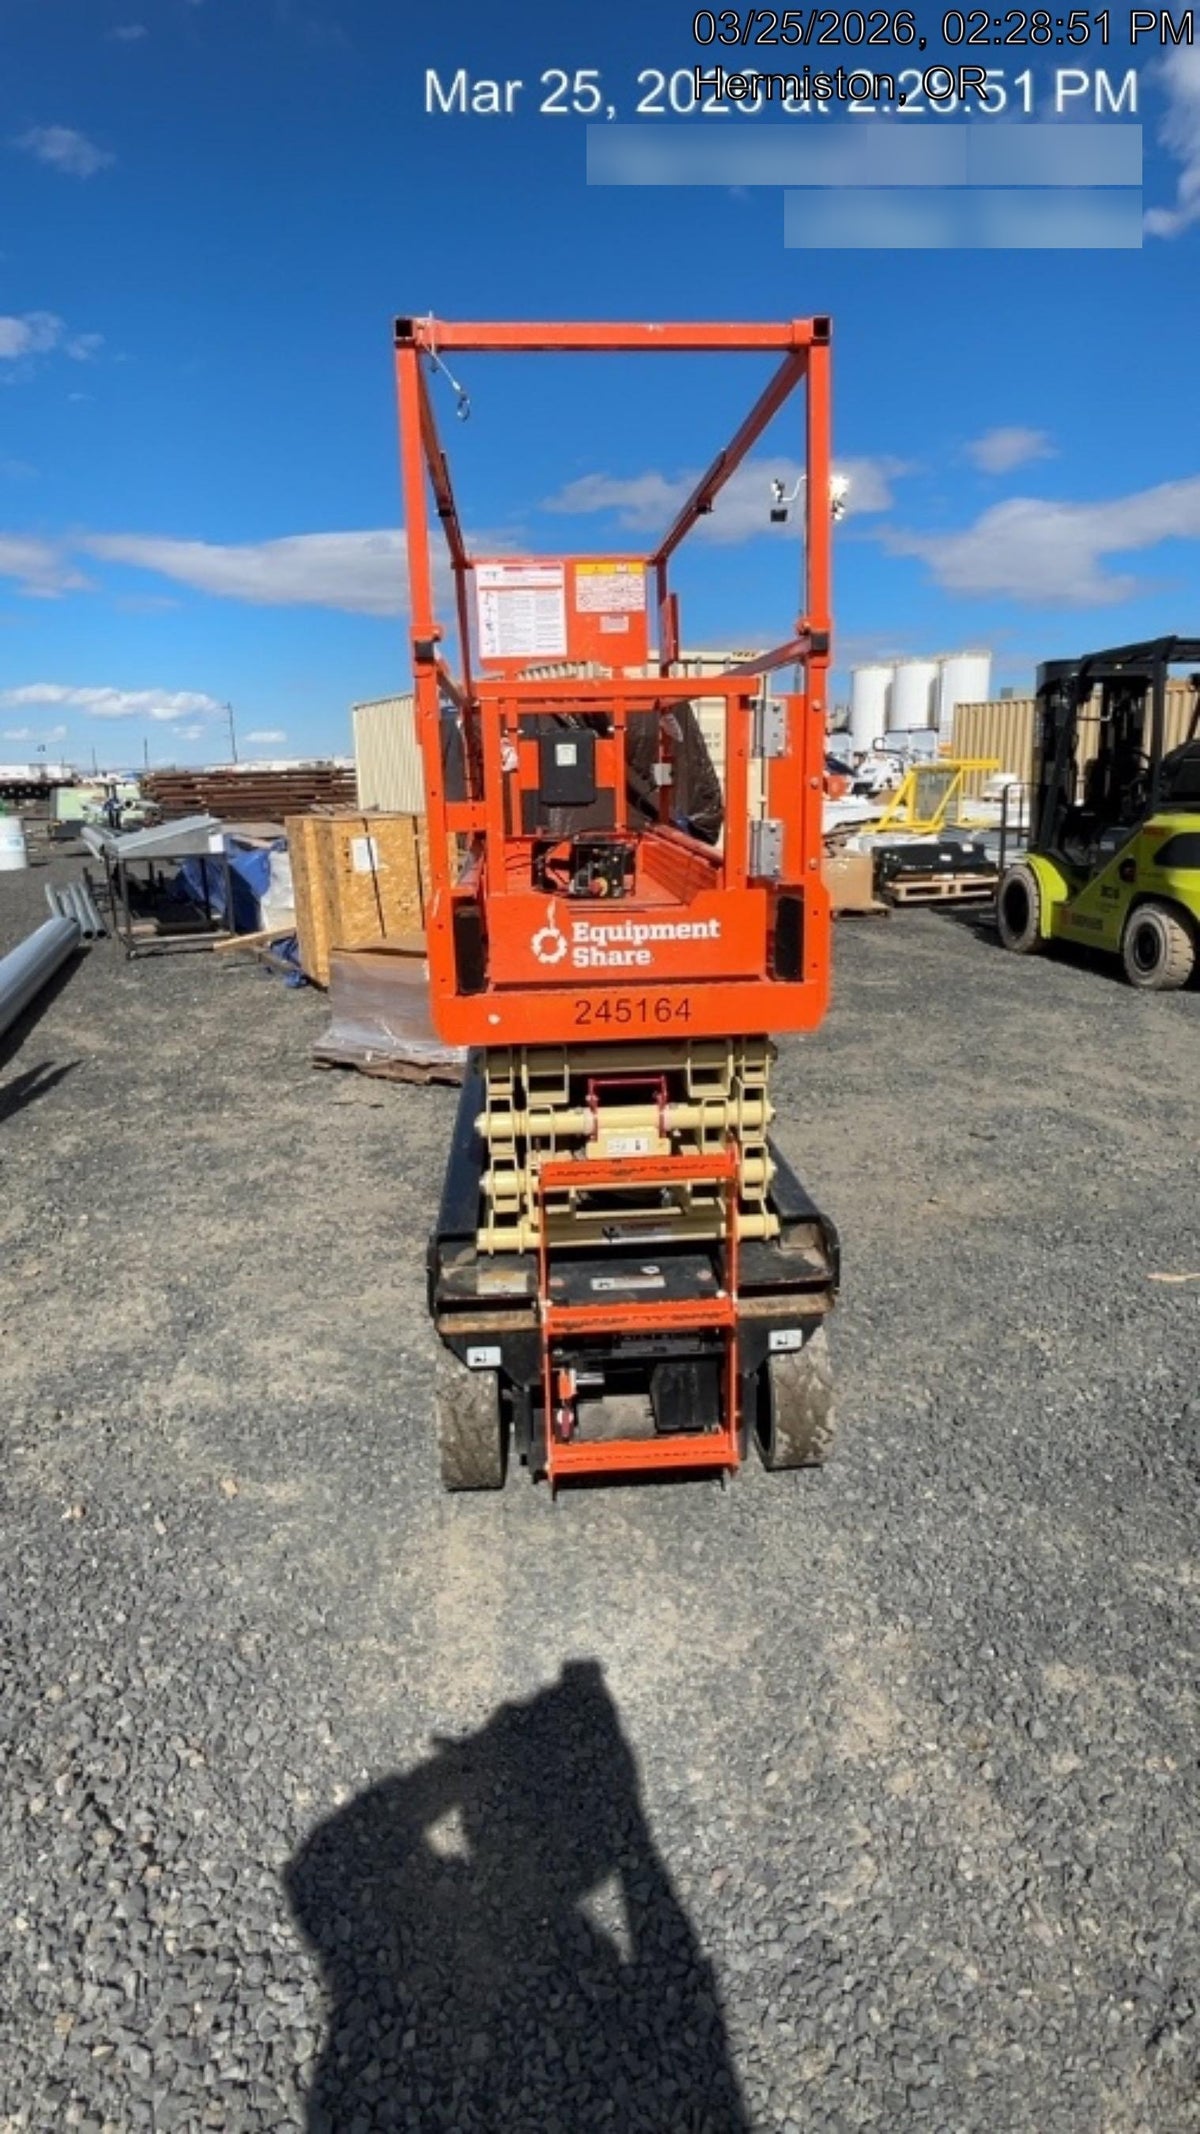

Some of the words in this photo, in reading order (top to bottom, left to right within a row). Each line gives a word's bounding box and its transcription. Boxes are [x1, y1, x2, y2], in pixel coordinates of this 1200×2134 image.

[571, 919, 720, 946] Equipment
[572, 945, 651, 968] Share
[575, 997, 691, 1025] 245164
